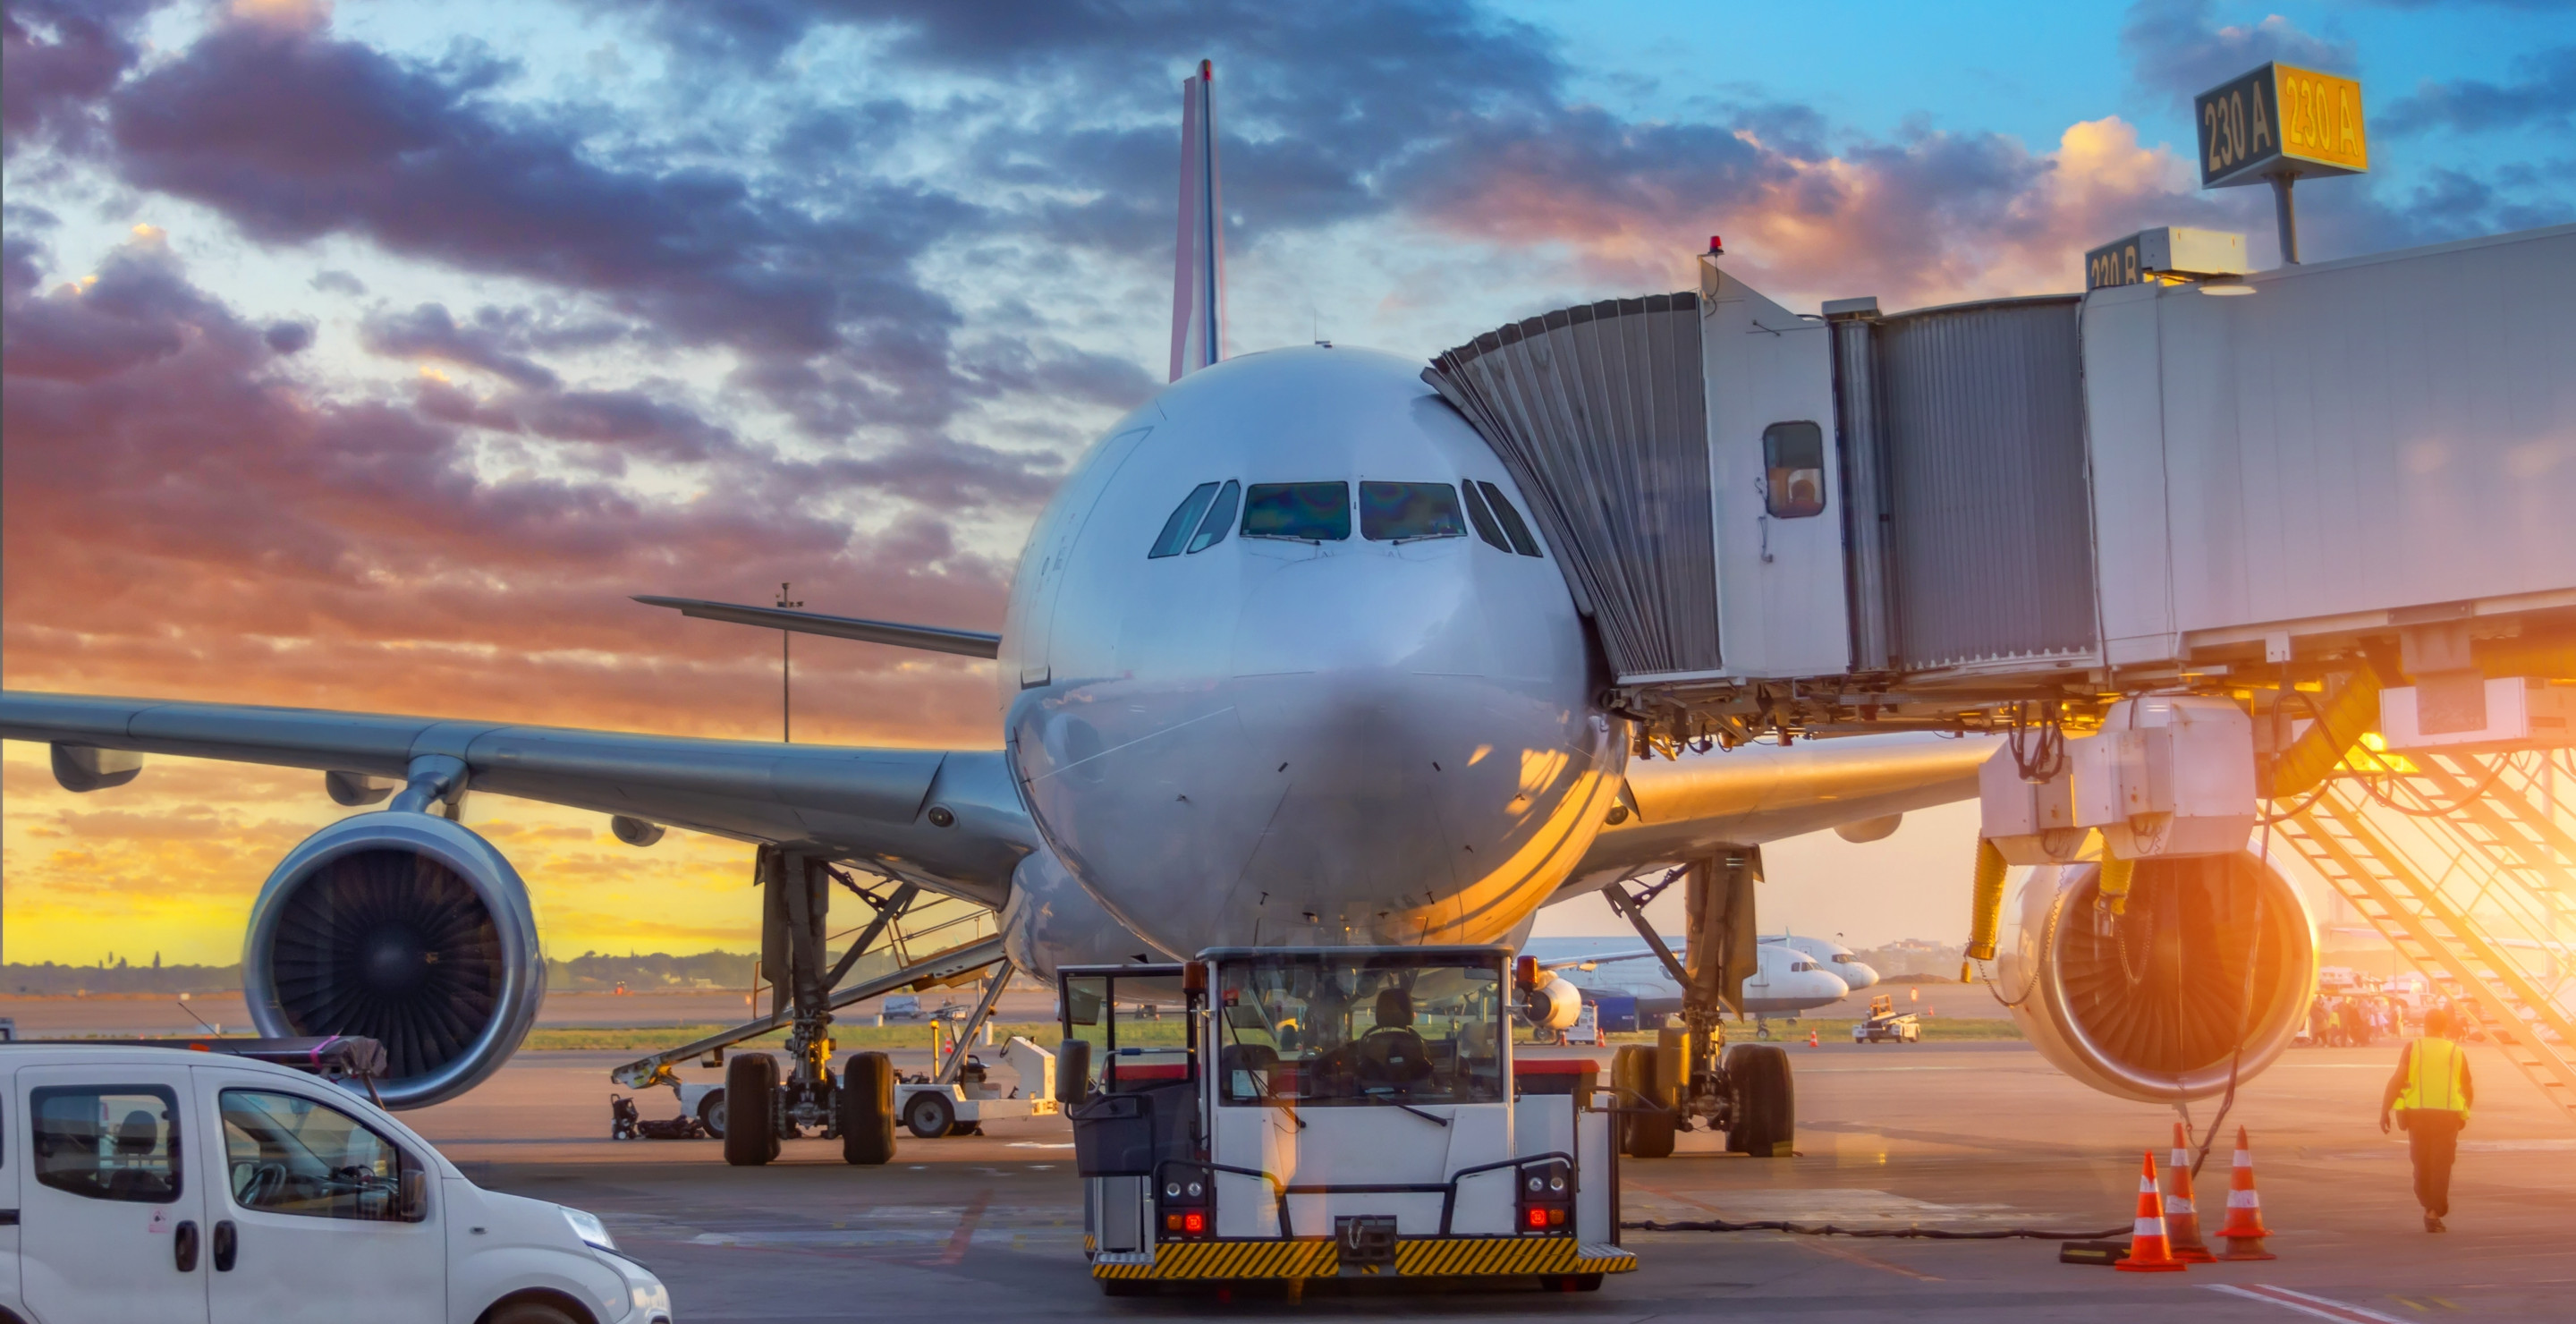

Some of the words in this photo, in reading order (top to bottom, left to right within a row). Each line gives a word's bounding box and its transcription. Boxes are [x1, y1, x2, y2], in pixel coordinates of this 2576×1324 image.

[2205, 90, 2246, 173] 230
[2252, 80, 2272, 154] A
[2285, 75, 2331, 152] 230
[2338, 86, 2360, 157] A
